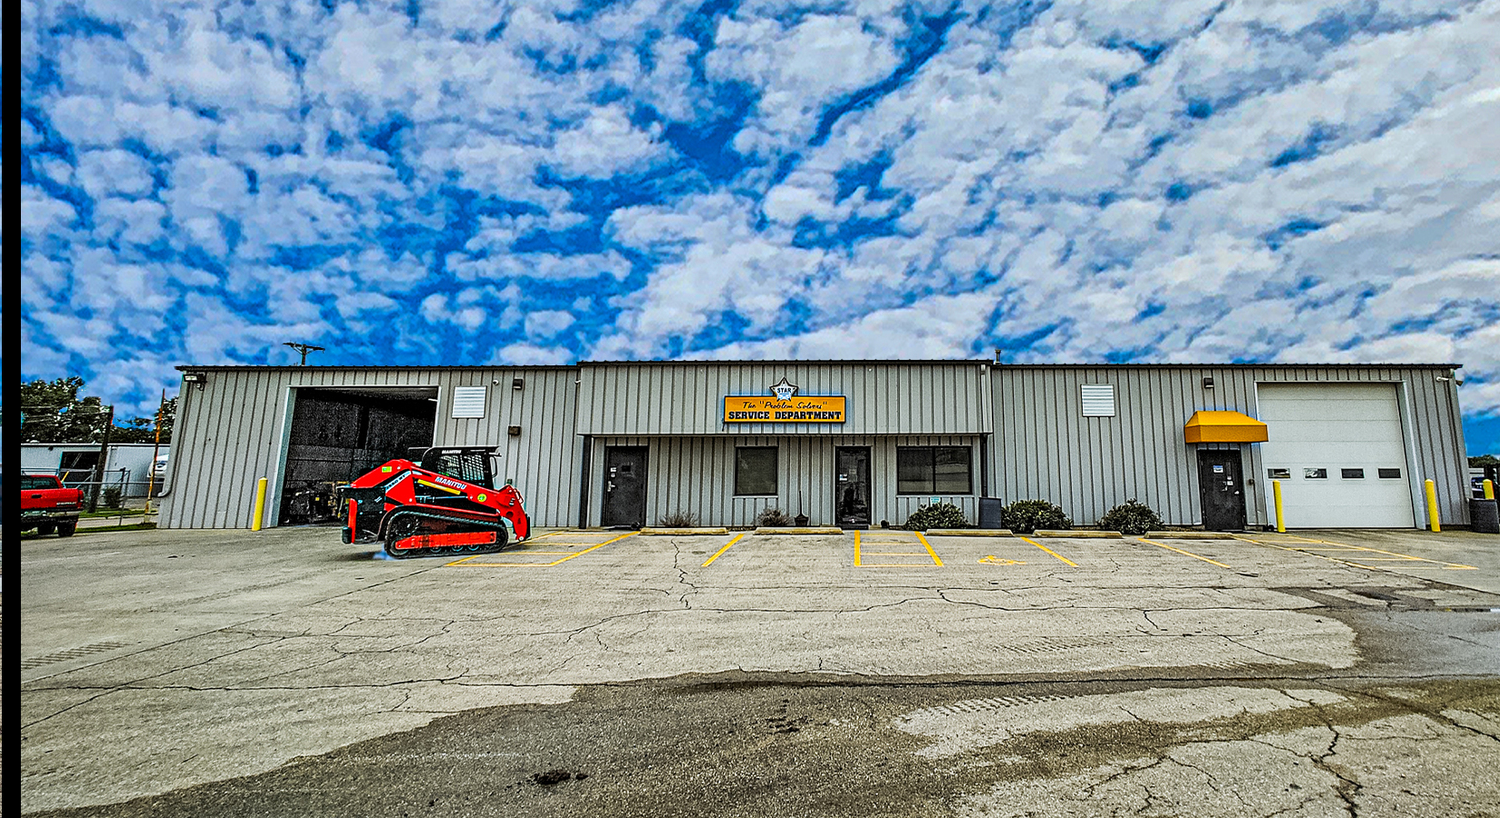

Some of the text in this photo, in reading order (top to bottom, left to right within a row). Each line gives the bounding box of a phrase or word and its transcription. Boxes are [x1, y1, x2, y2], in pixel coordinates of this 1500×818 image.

[728, 411, 842, 420] SERVICE DEPARTMENT
[434, 476, 468, 490] MANITOU
